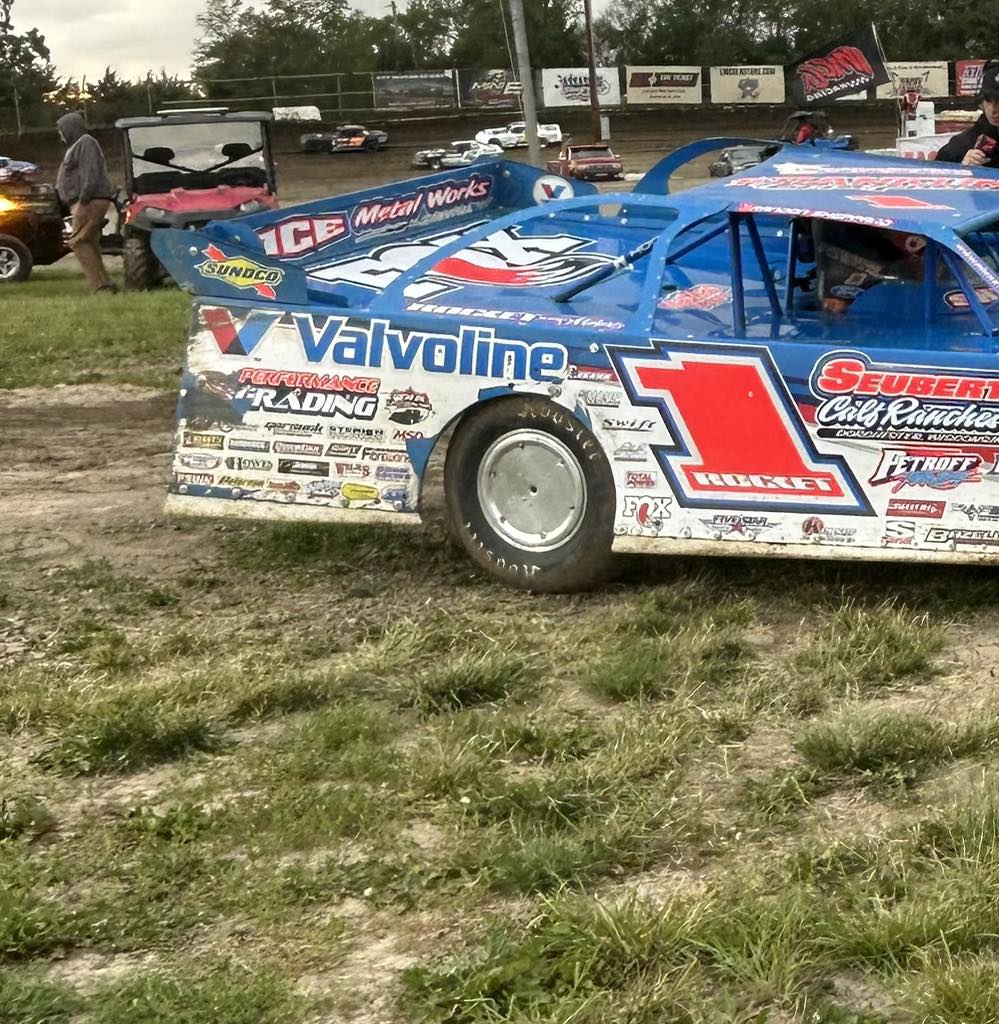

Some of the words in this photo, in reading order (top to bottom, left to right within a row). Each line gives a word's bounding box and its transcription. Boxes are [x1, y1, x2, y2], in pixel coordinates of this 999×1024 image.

[355, 193, 424, 228] Metal
[427, 179, 490, 209] Works
[204, 261, 282, 283] SUNOCO
[293, 312, 568, 383] Valvoline
[239, 368, 381, 394] PERFORMANCE
[620, 350, 861, 508] 1
[873, 449, 979, 481] PETROFF
[622, 495, 673, 520] FOX
